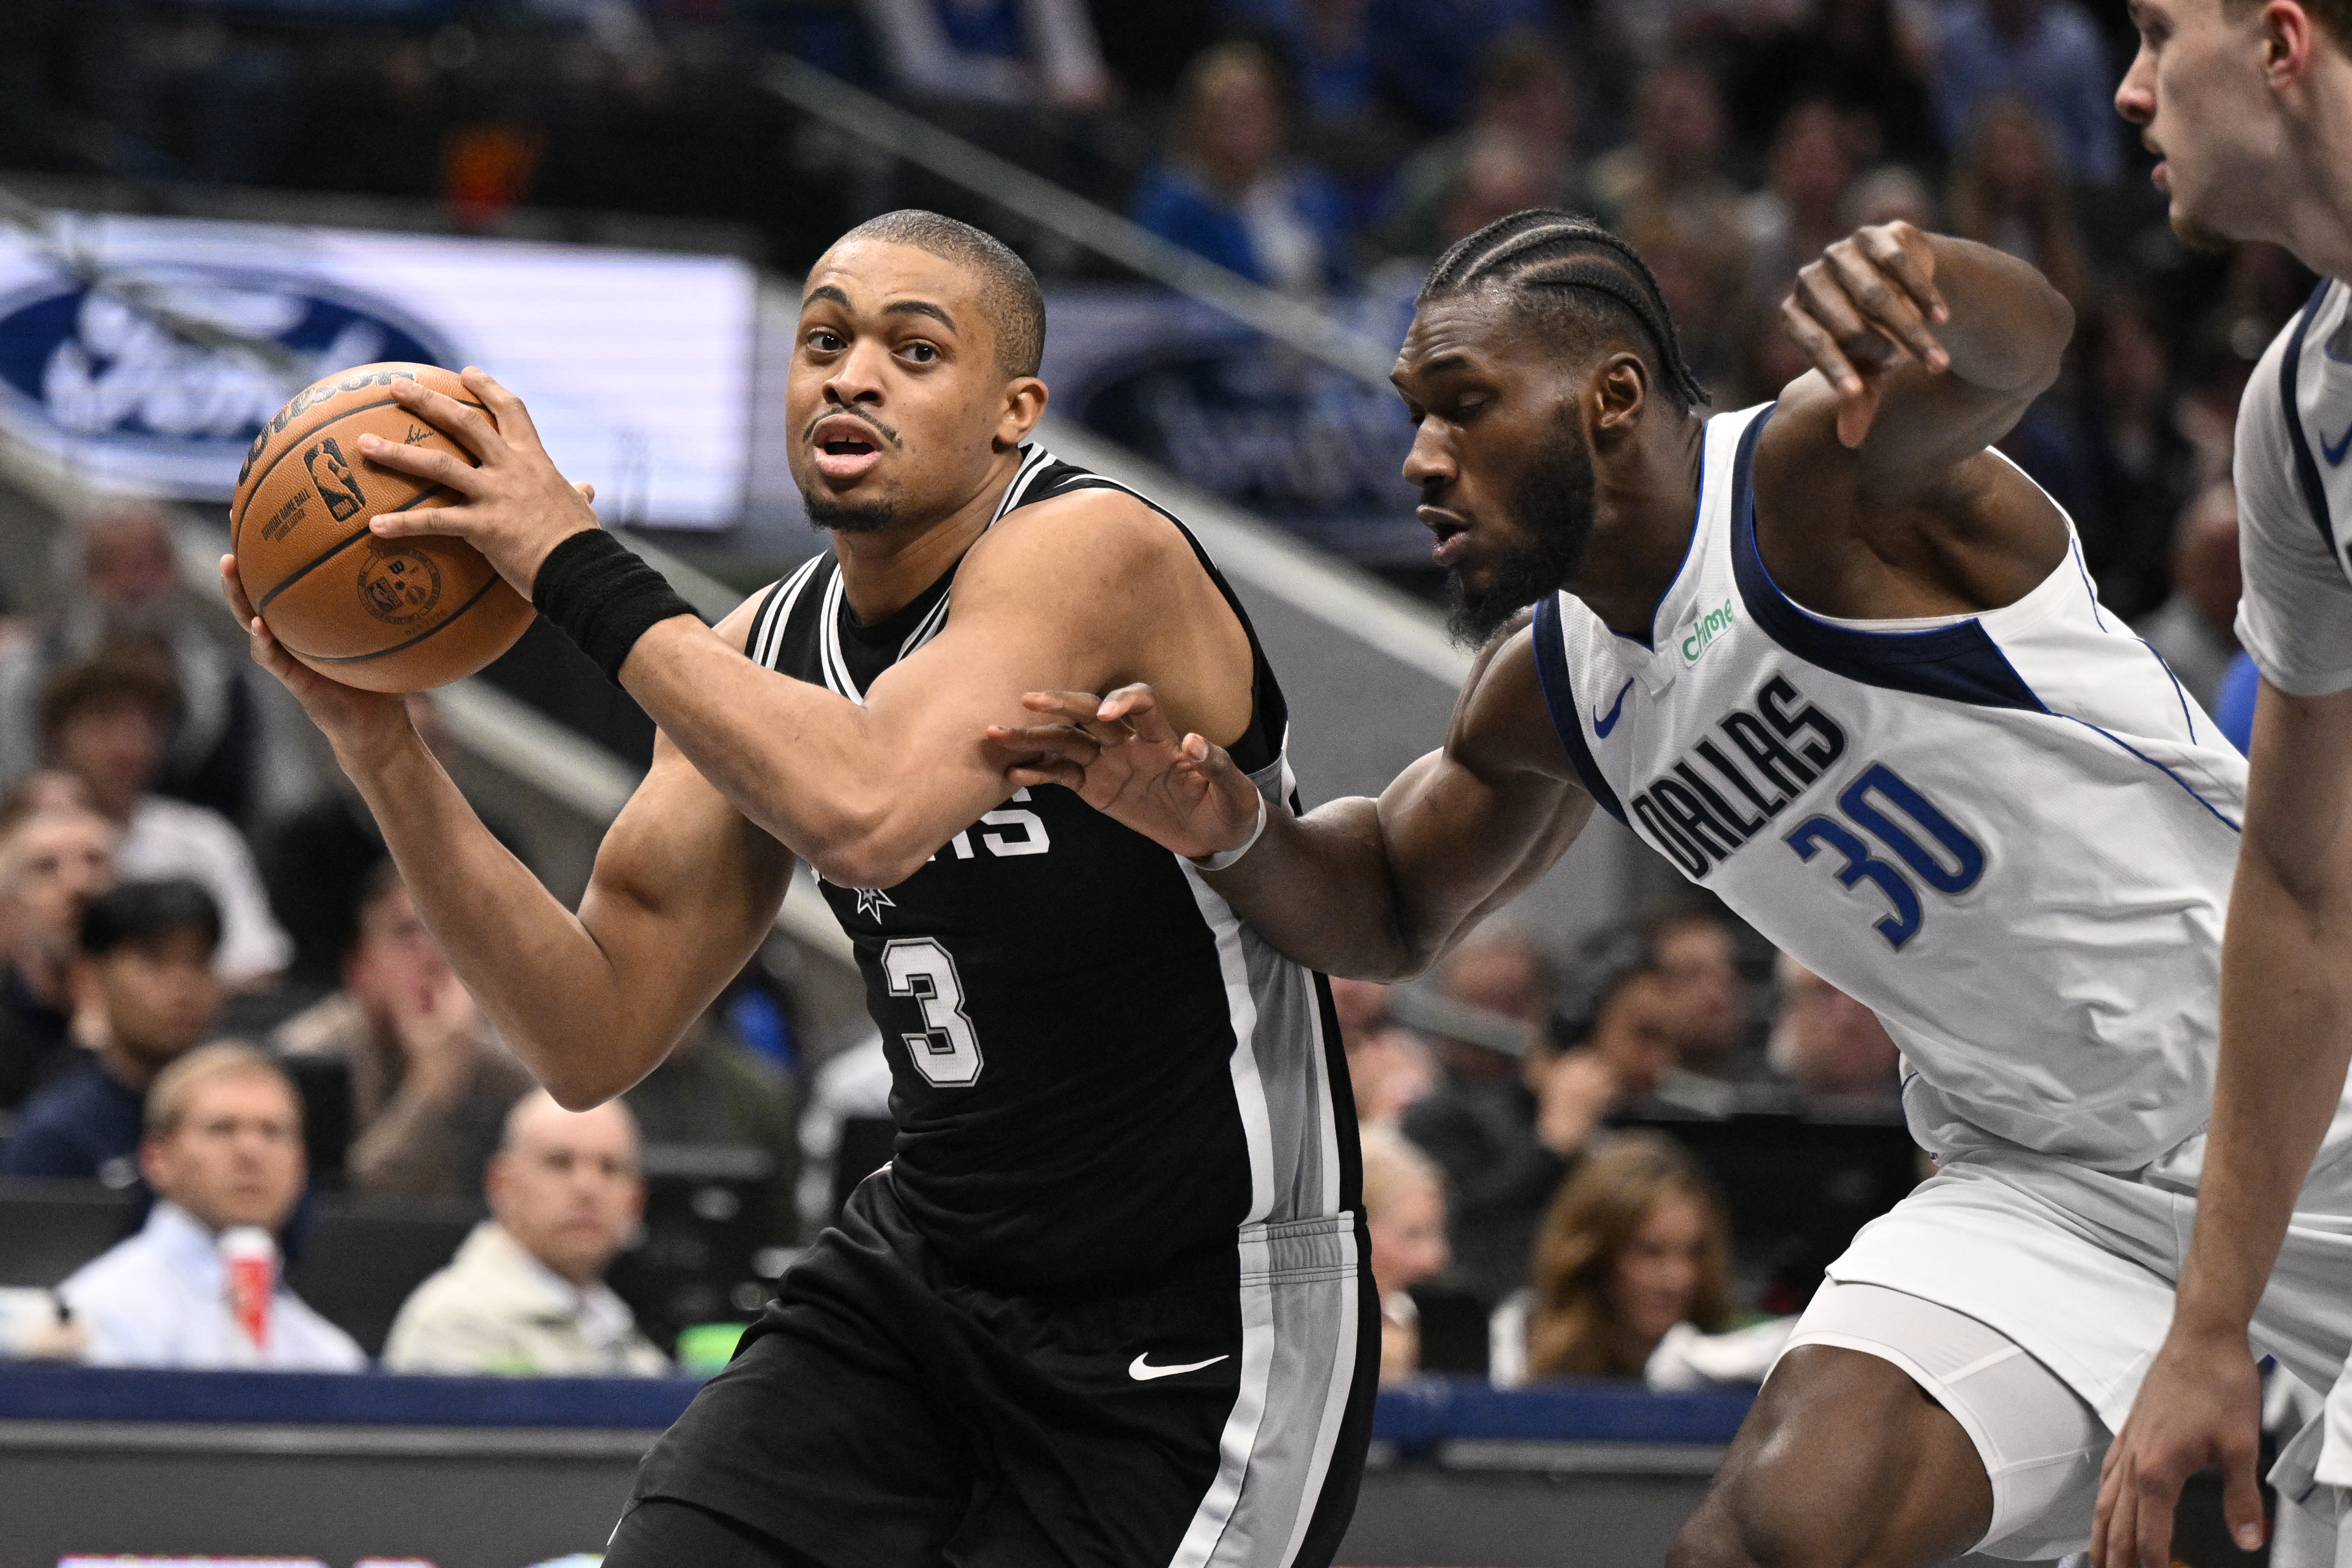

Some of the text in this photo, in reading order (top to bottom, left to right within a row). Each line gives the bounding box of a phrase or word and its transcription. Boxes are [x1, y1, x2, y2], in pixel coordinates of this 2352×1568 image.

[262, 488, 311, 541] OFFICIAL GAME BALL
[332, 498, 354, 519] NBA
[1682, 598, 1733, 661] chime
[1629, 670, 1849, 880] DALLAS
[1781, 759, 1987, 953] 30
[881, 937, 985, 1088] 3
